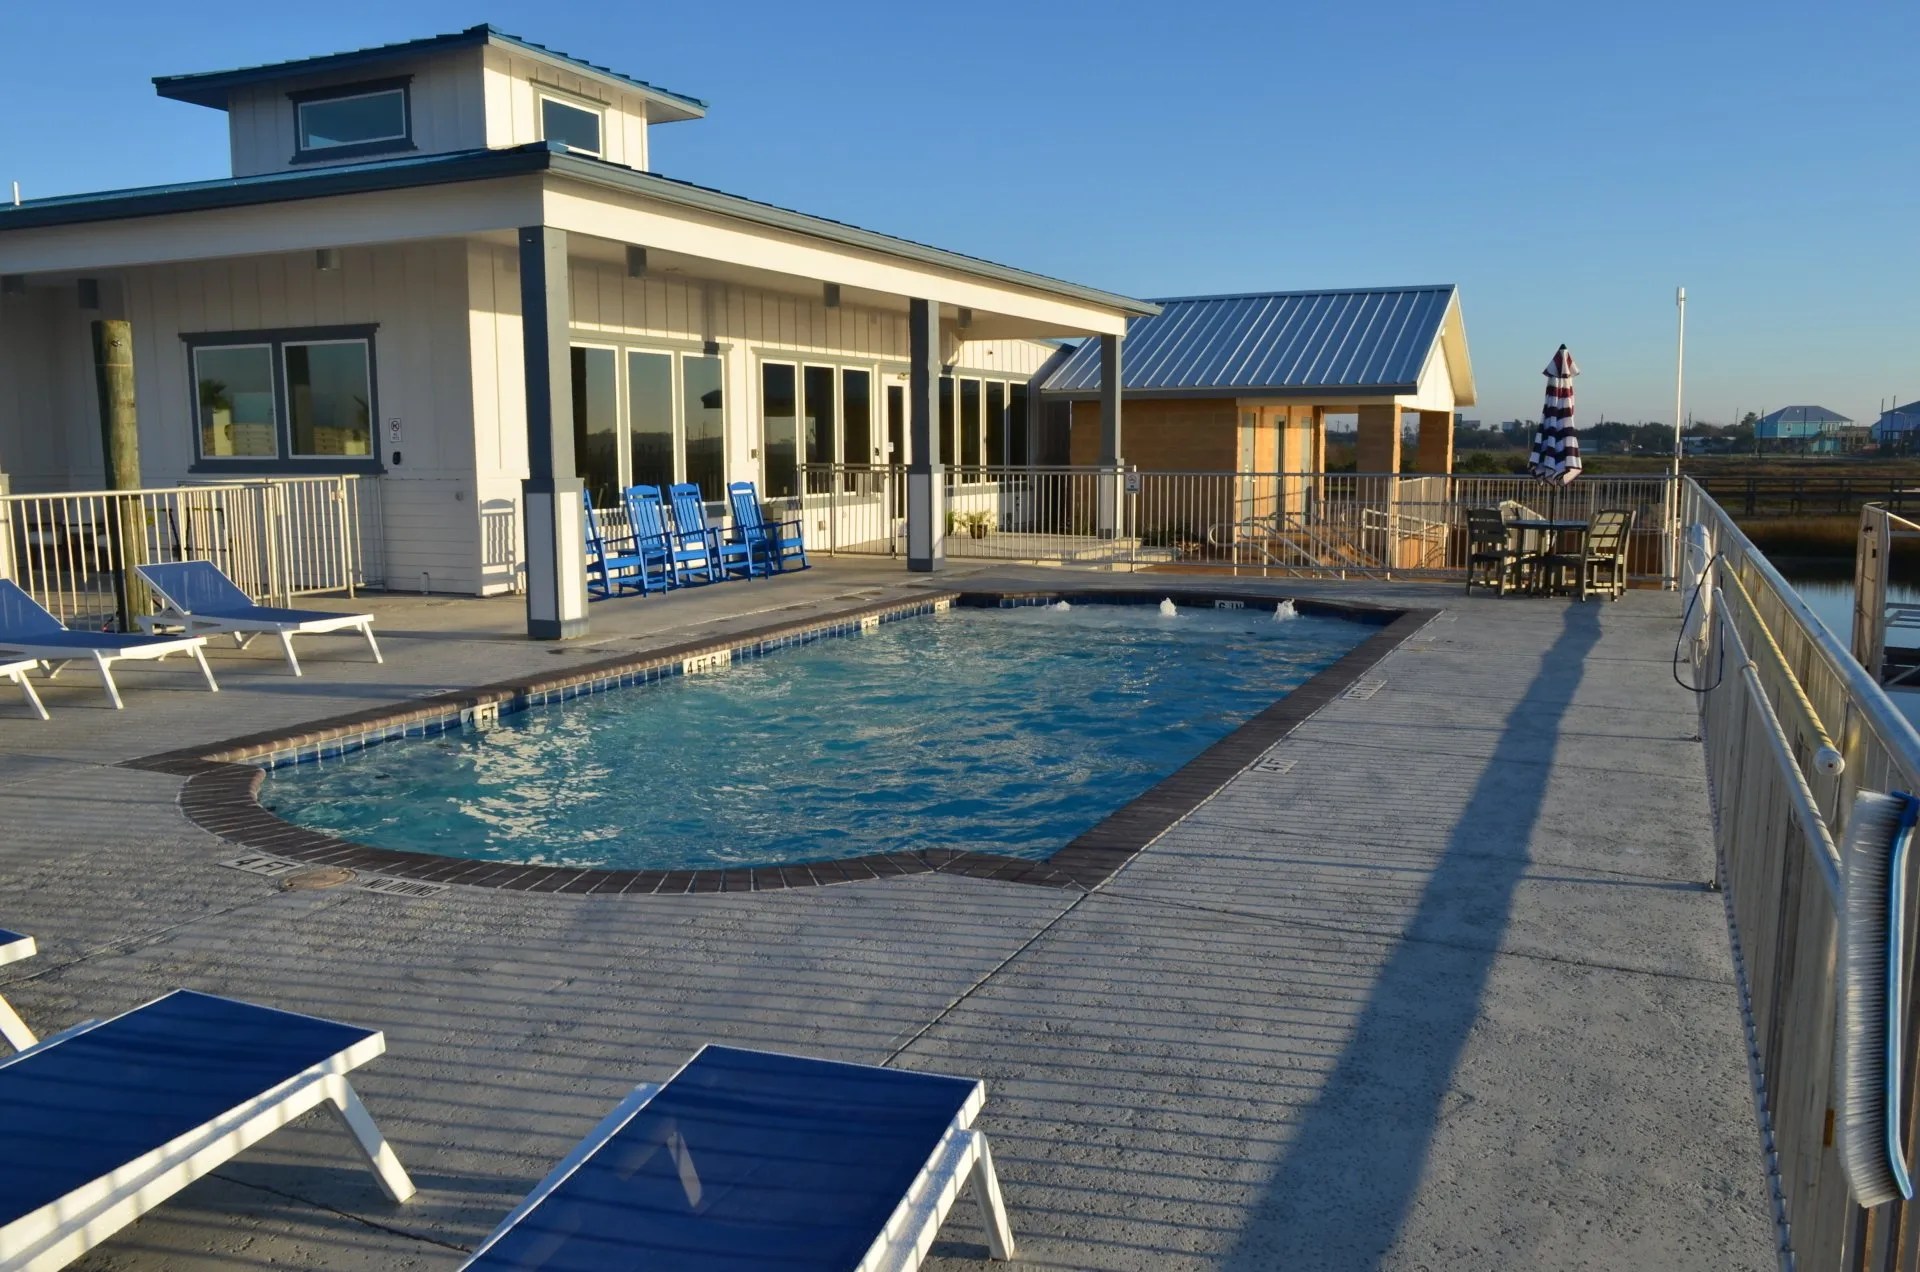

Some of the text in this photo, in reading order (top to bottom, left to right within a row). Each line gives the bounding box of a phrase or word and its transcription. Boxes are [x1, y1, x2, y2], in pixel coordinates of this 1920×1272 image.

[688, 662, 693, 674] 4
[697, 658, 707, 672] FT
[482, 706, 496, 721] FT
[235, 858, 297, 873] 4 FT
[360, 877, 441, 897] NO DIVING
